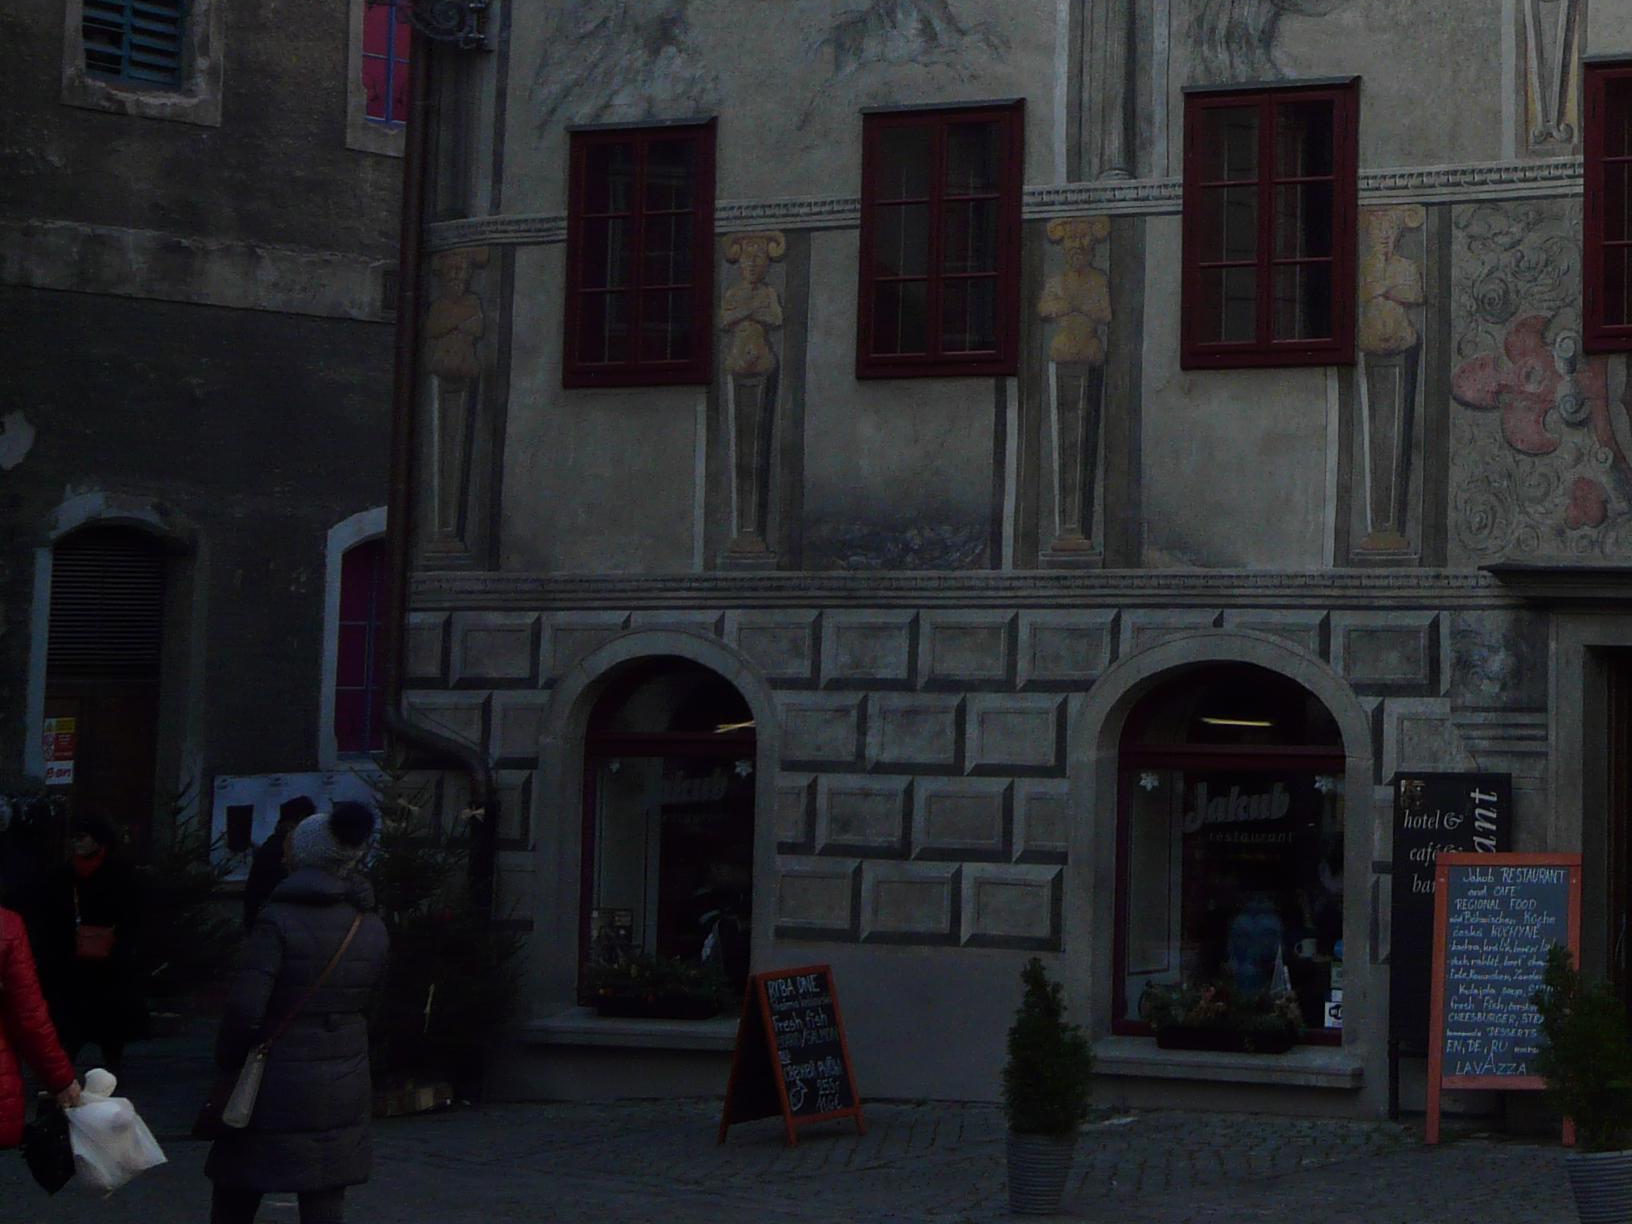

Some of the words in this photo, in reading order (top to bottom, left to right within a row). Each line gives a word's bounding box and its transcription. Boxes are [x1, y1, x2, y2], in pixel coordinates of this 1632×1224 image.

[1182, 780, 1291, 834] Jakub
[1403, 809, 1440, 829] hotel
[1443, 812, 1465, 830] &
[1209, 830, 1297, 843] restaurant
[1500, 867, 1568, 884] RESTAURANT
[1455, 898, 1501, 911] REGIONAL
[1510, 898, 1537, 910] FOOD
[771, 1010, 804, 1033] Fresh
[805, 1007, 828, 1029] fish
[1491, 1039, 1509, 1052] RU
[1455, 1052, 1527, 1076] LAVAZZA
